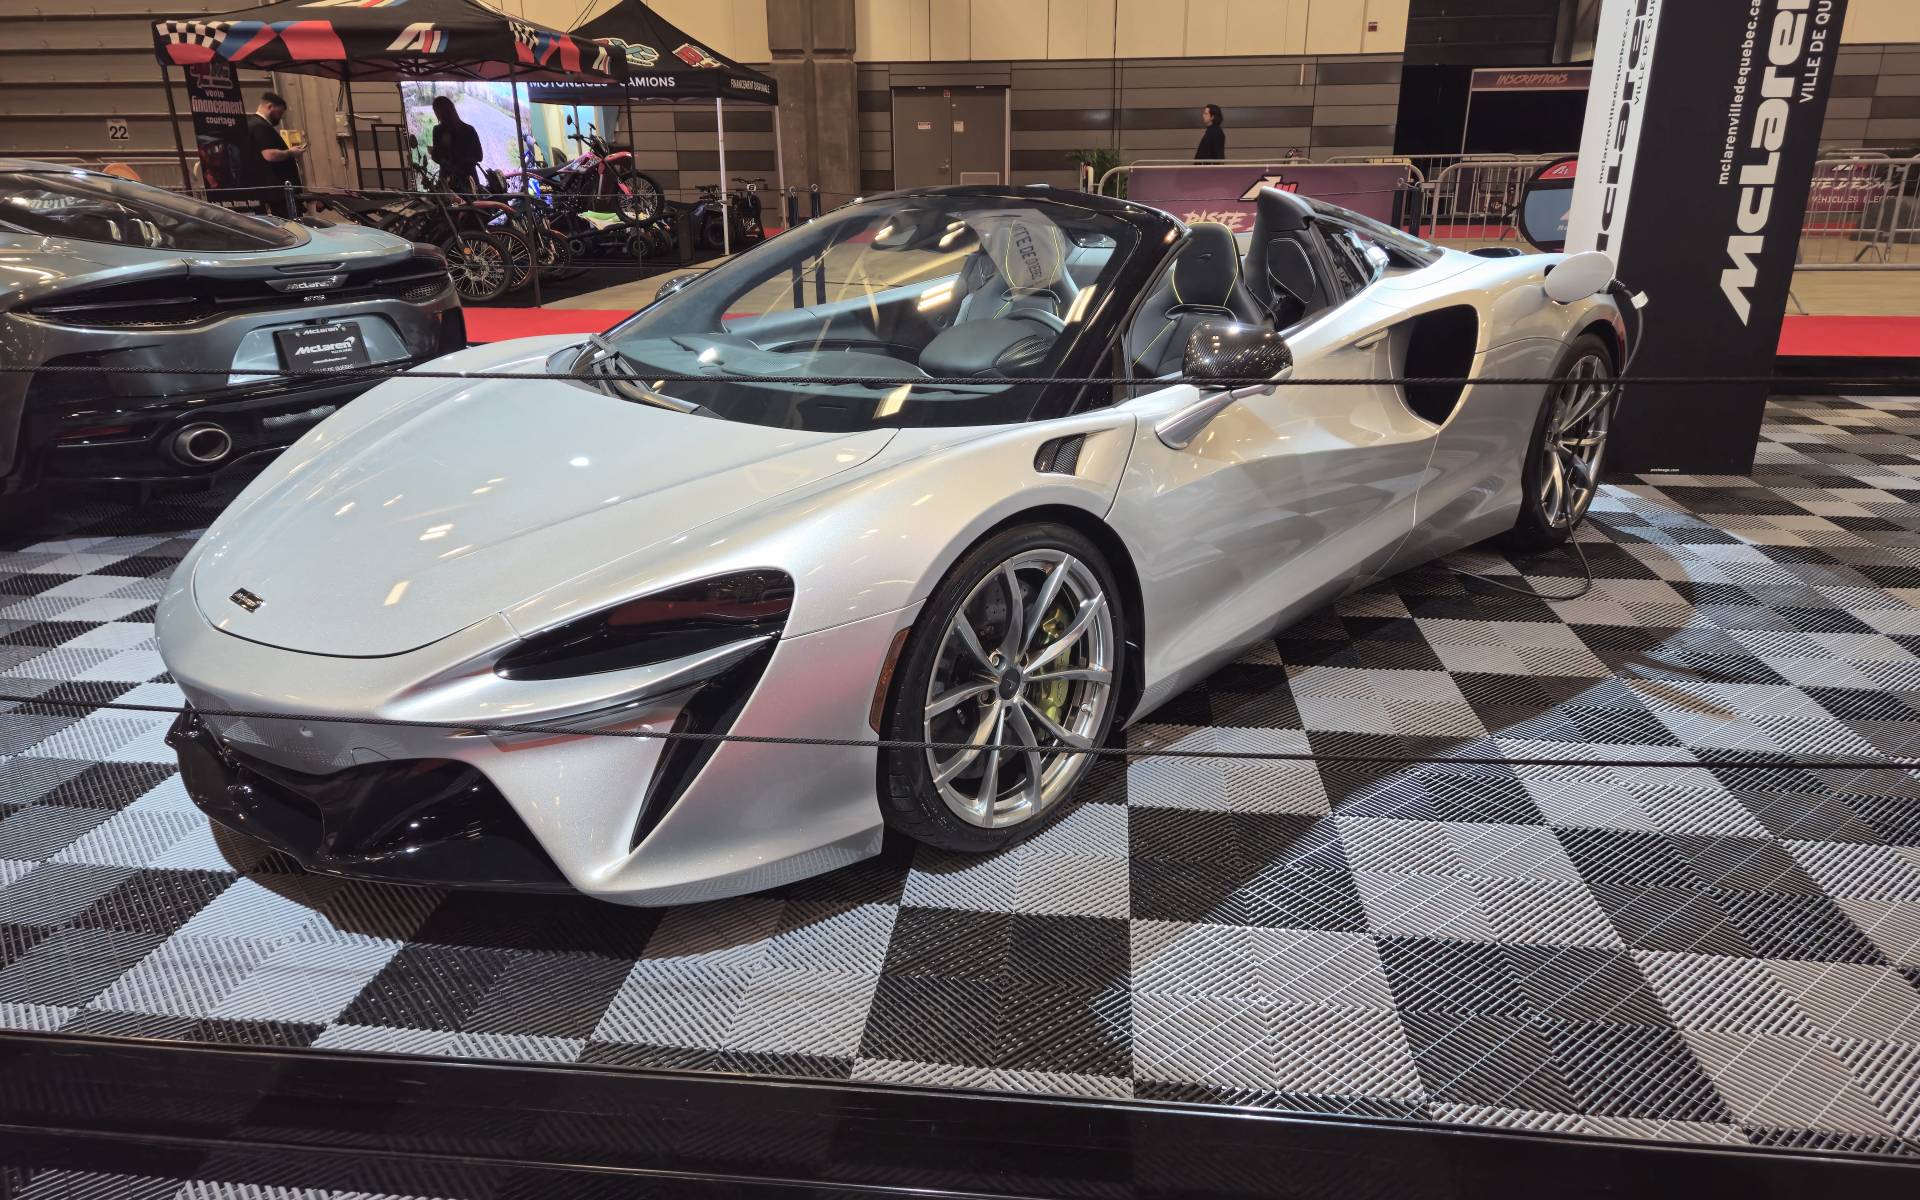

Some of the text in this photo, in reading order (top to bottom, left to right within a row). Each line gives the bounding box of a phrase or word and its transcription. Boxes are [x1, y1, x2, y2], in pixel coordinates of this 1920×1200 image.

[1810, 29, 1826, 52] DE
[1496, 74, 1568, 85] INSCRIPTIONS
[1634, 64, 1646, 105] VILLE
[1643, 33, 1650, 56] DE
[1800, 57, 1821, 103] VILLE
[1719, 0, 1761, 185] mclarenvilledequebec.ca
[109, 126, 128, 139] 22
[1720, 0, 1810, 327] McLare
[303, 327, 338, 336] McLaren
[295, 341, 352, 356] McLaren
